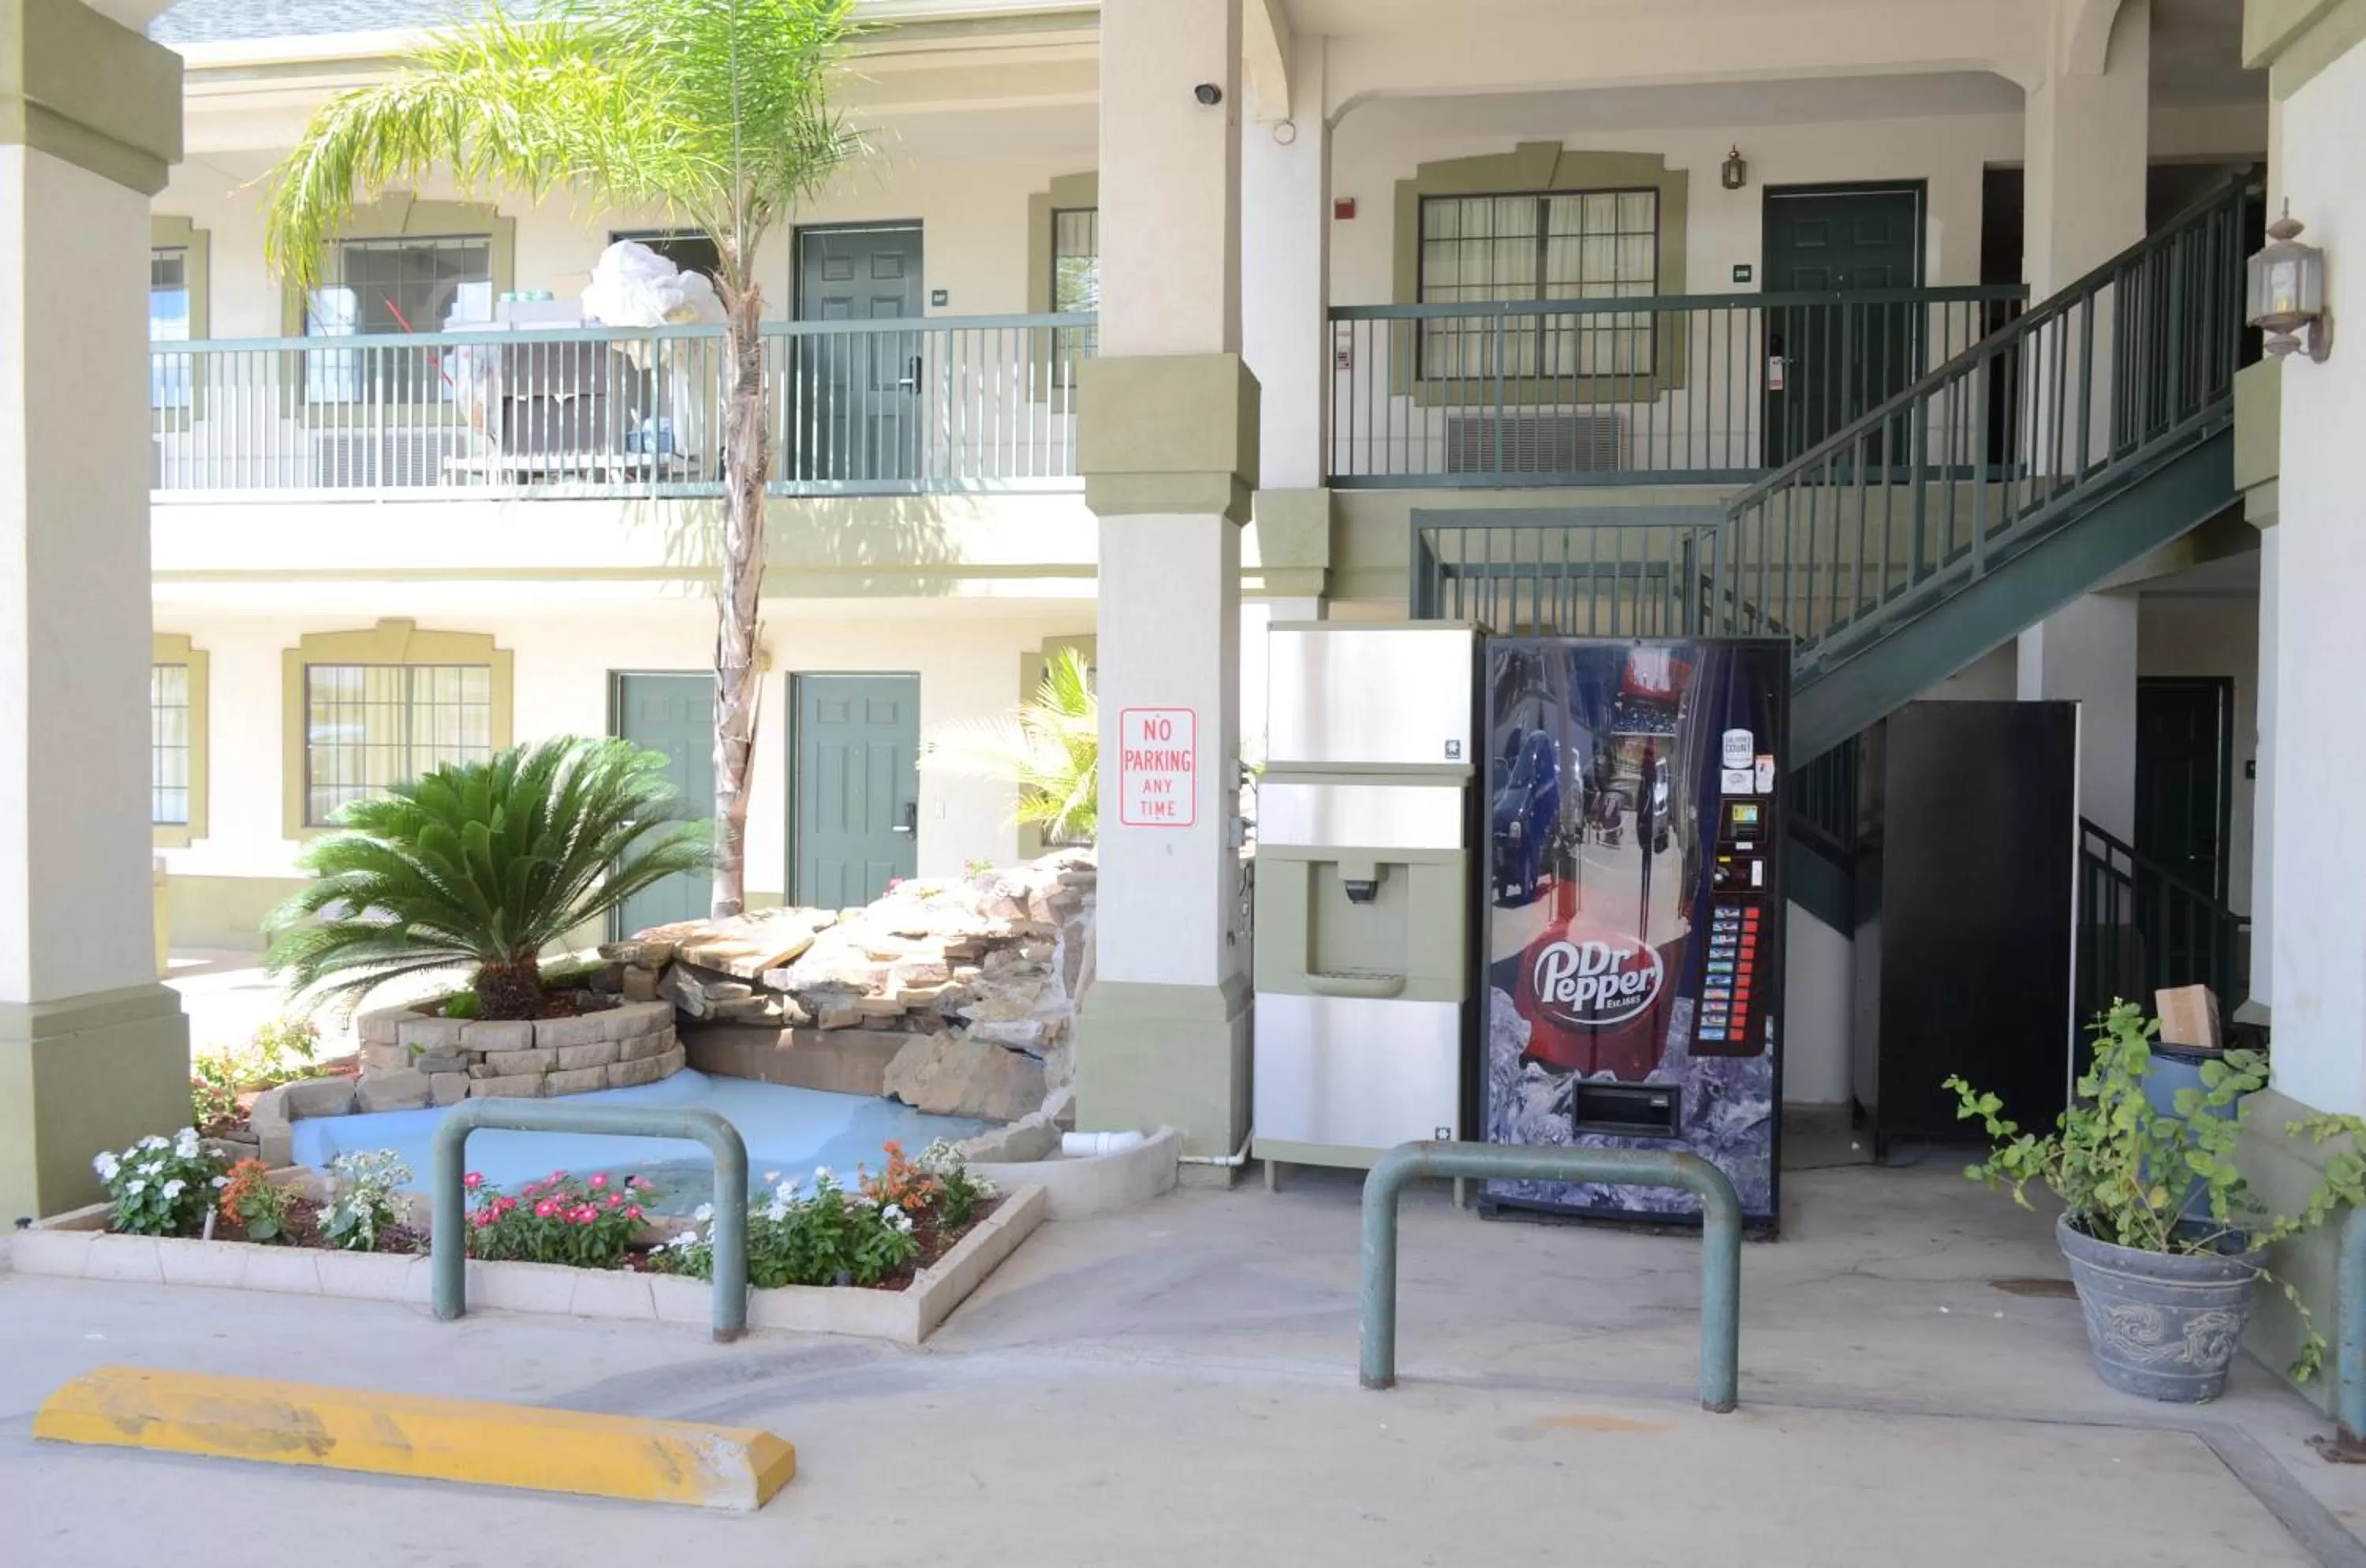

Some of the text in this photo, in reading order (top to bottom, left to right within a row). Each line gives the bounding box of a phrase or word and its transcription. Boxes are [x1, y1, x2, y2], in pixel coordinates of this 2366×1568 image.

[1144, 719, 1172, 742] NO
[1125, 749, 1192, 772] PARKING
[1142, 778, 1173, 793] ANY
[1139, 801, 1177, 817] TIME
[1578, 940, 1631, 976] Dr
[1535, 941, 1657, 1013] Pepper
